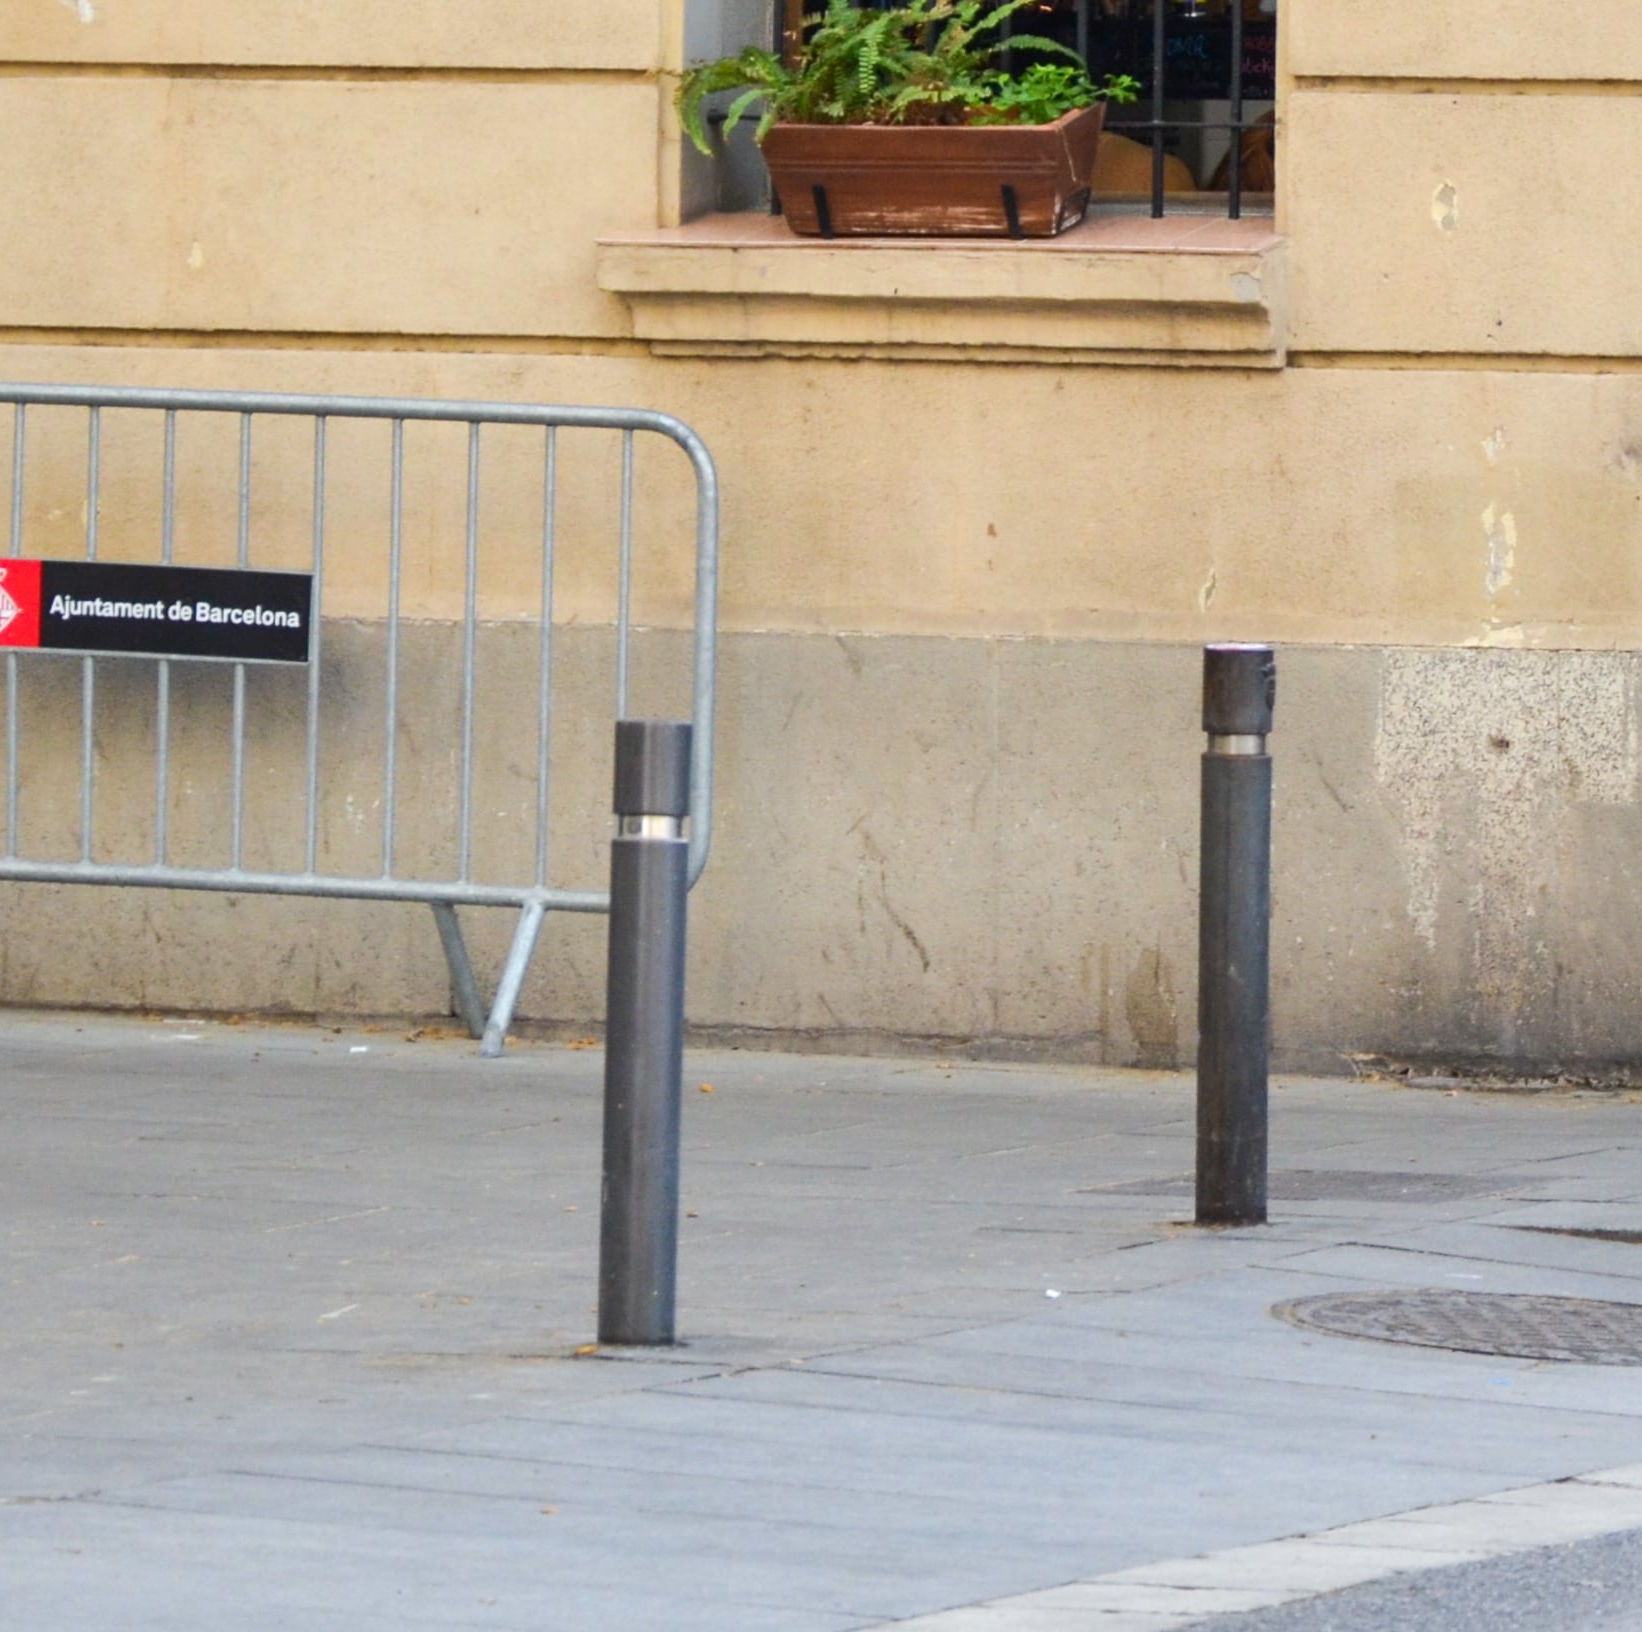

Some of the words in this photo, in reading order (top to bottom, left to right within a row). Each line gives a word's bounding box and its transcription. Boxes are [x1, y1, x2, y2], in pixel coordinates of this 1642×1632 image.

[49, 594, 165, 620] Ajuntament
[168, 602, 192, 621] de
[195, 601, 301, 628] Barcelona
